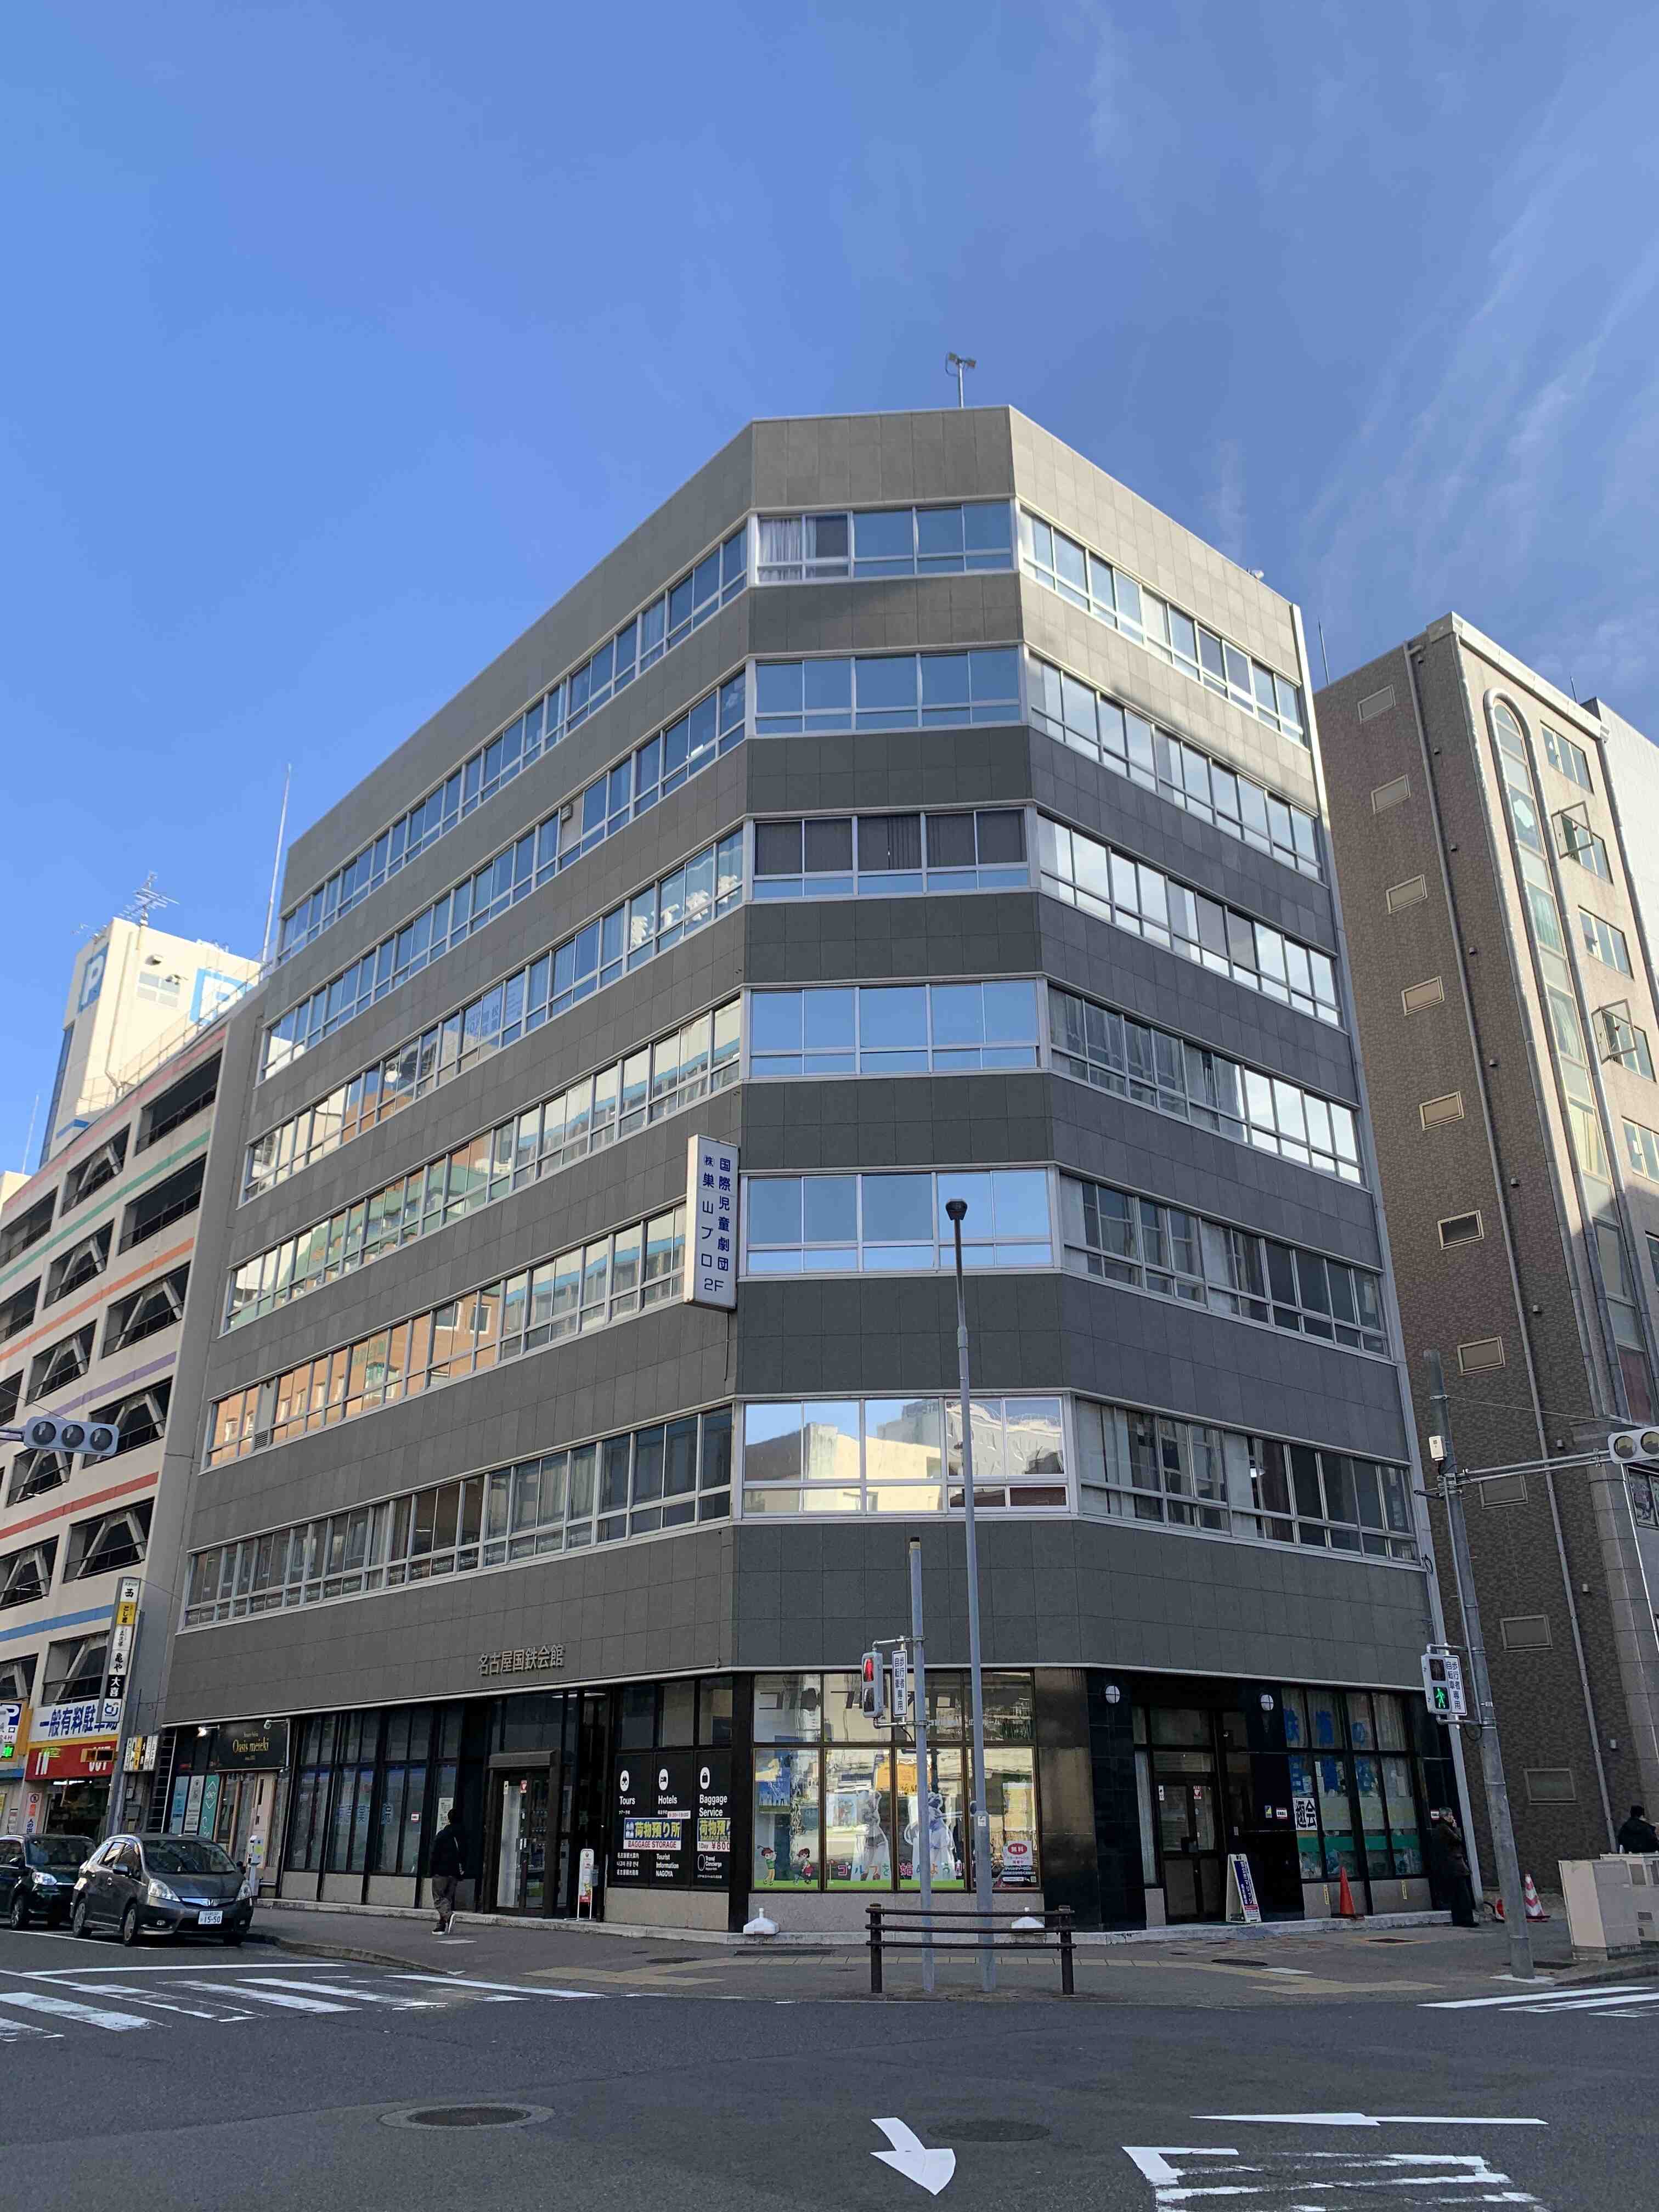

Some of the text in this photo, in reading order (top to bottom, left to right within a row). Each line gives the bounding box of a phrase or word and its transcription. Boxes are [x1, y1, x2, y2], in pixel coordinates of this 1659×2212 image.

[82, 954, 104, 1003] P
[717, 1157, 731, 1272] 国際児童劇団
[704, 1278, 724, 1291] 2F
[114, 1652, 123, 1672] 亀や
[478, 1645, 563, 1675] 名古屋国鉄会館
[110, 1677, 121, 1697] 大喜
[619, 1796, 635, 1805] Tours
[658, 1795, 678, 1804] Hotels
[699, 1794, 727, 1805] Baggage
[699, 1807, 723, 1816] Service
[635, 1821, 680, 1838] 荷物預り所
